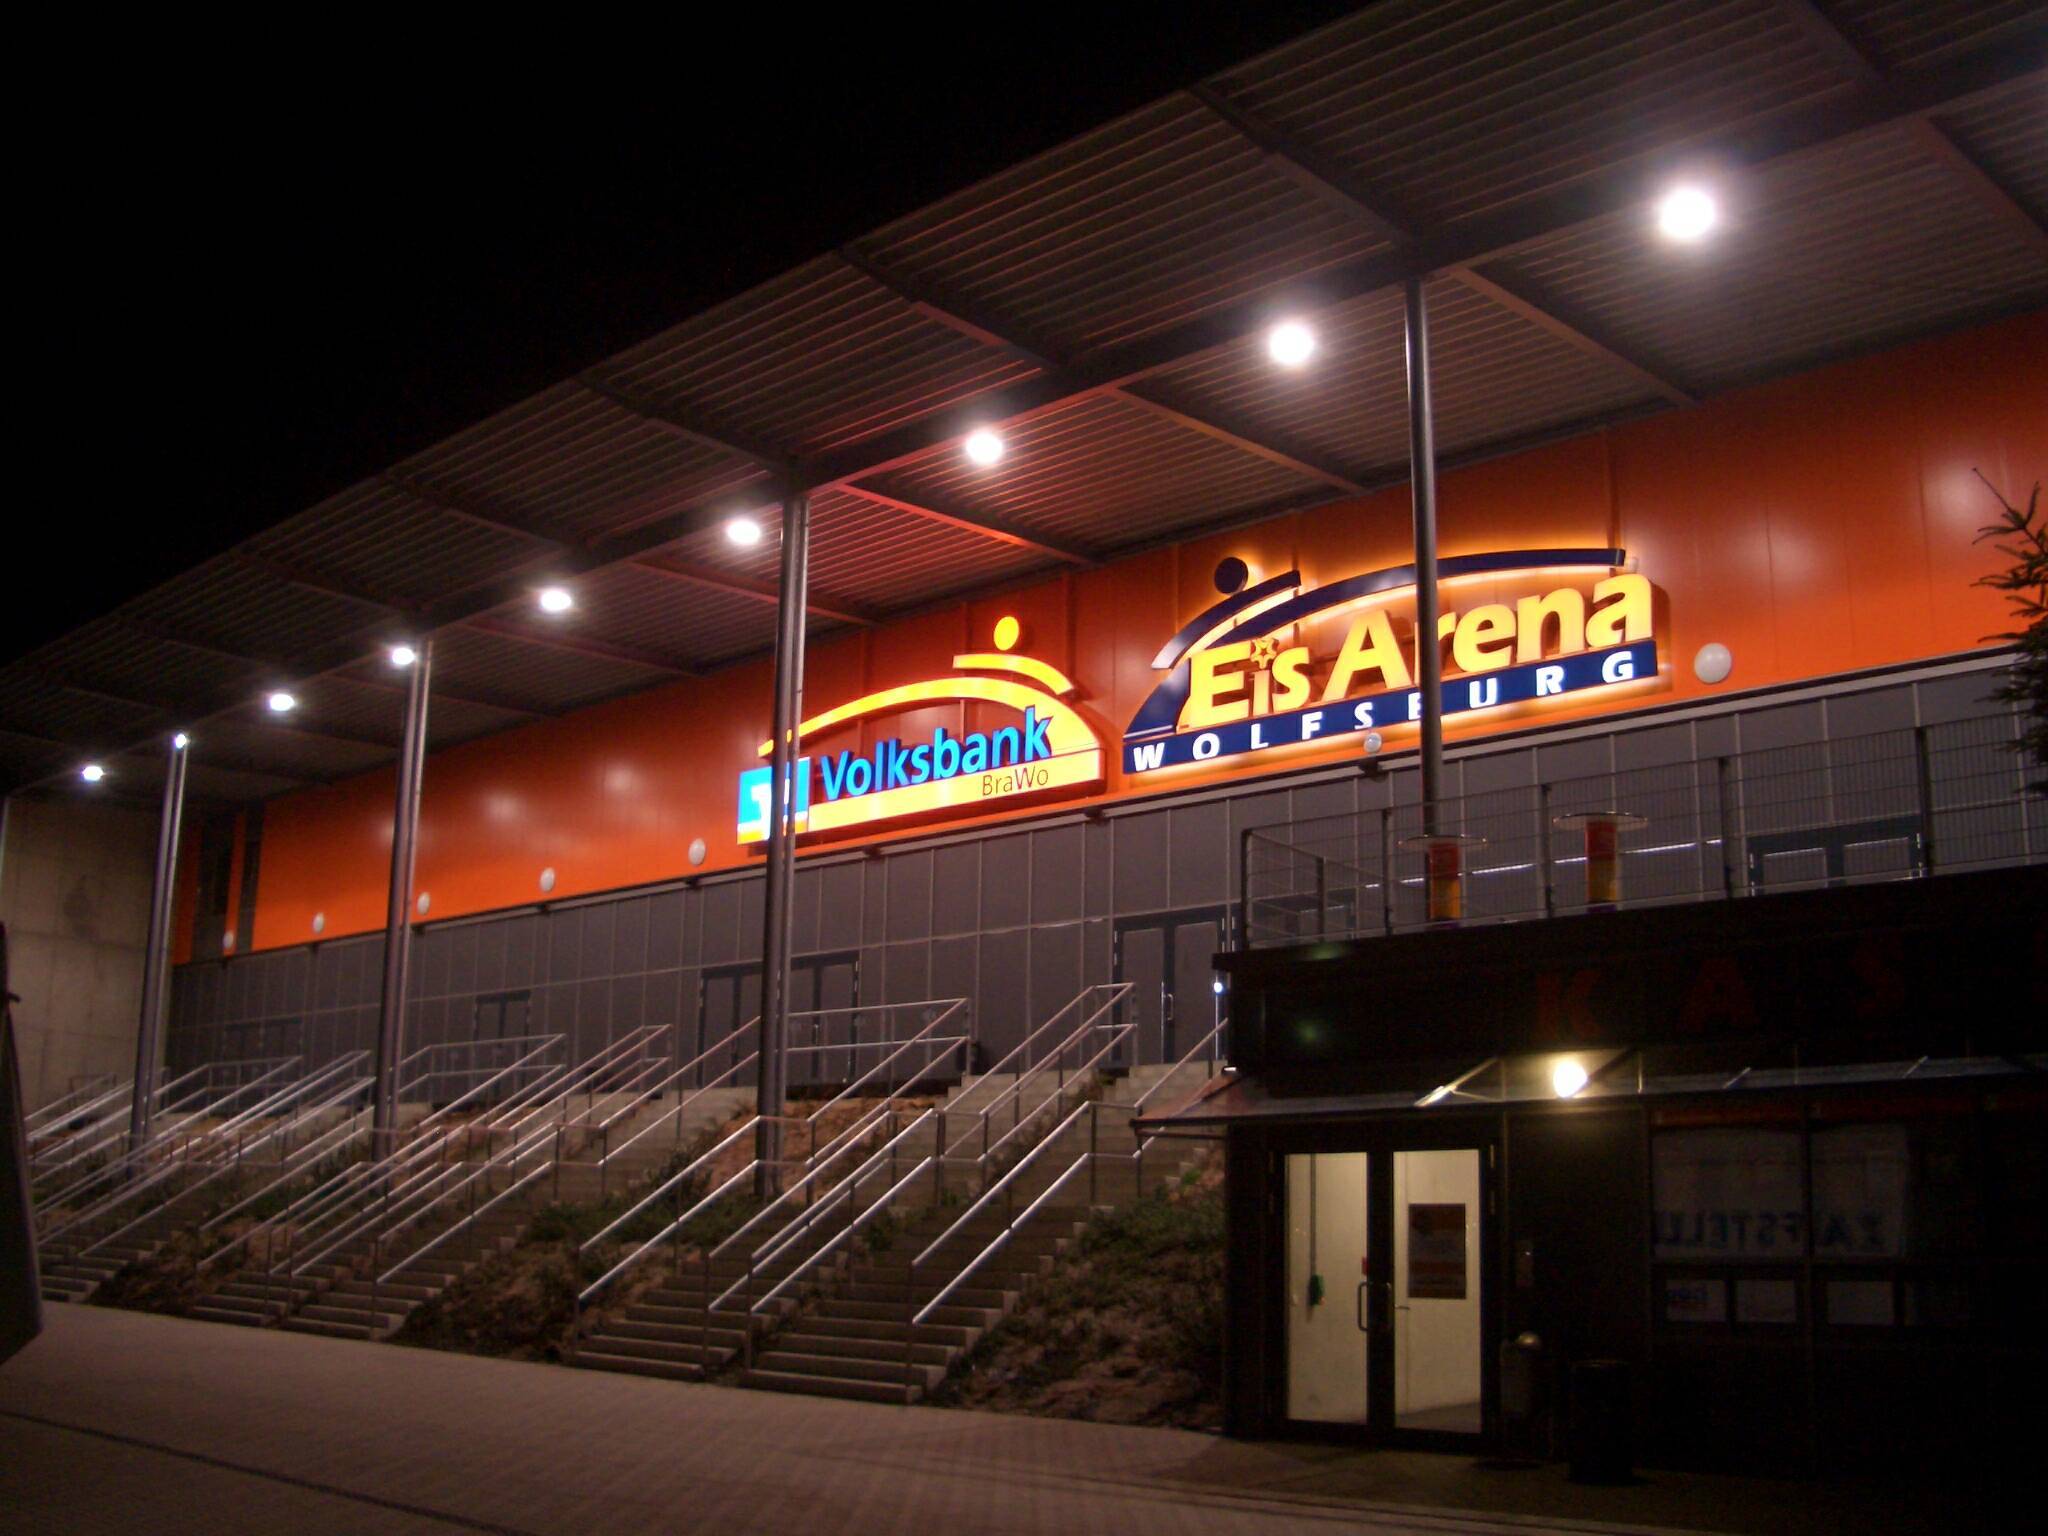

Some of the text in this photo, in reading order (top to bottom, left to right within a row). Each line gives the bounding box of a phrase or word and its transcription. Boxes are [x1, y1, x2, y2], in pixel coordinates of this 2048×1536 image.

[820, 703, 1053, 801] Volksbank
[1132, 650, 1635, 772] WOLFSBURG
[981, 765, 1050, 797] BraWo
